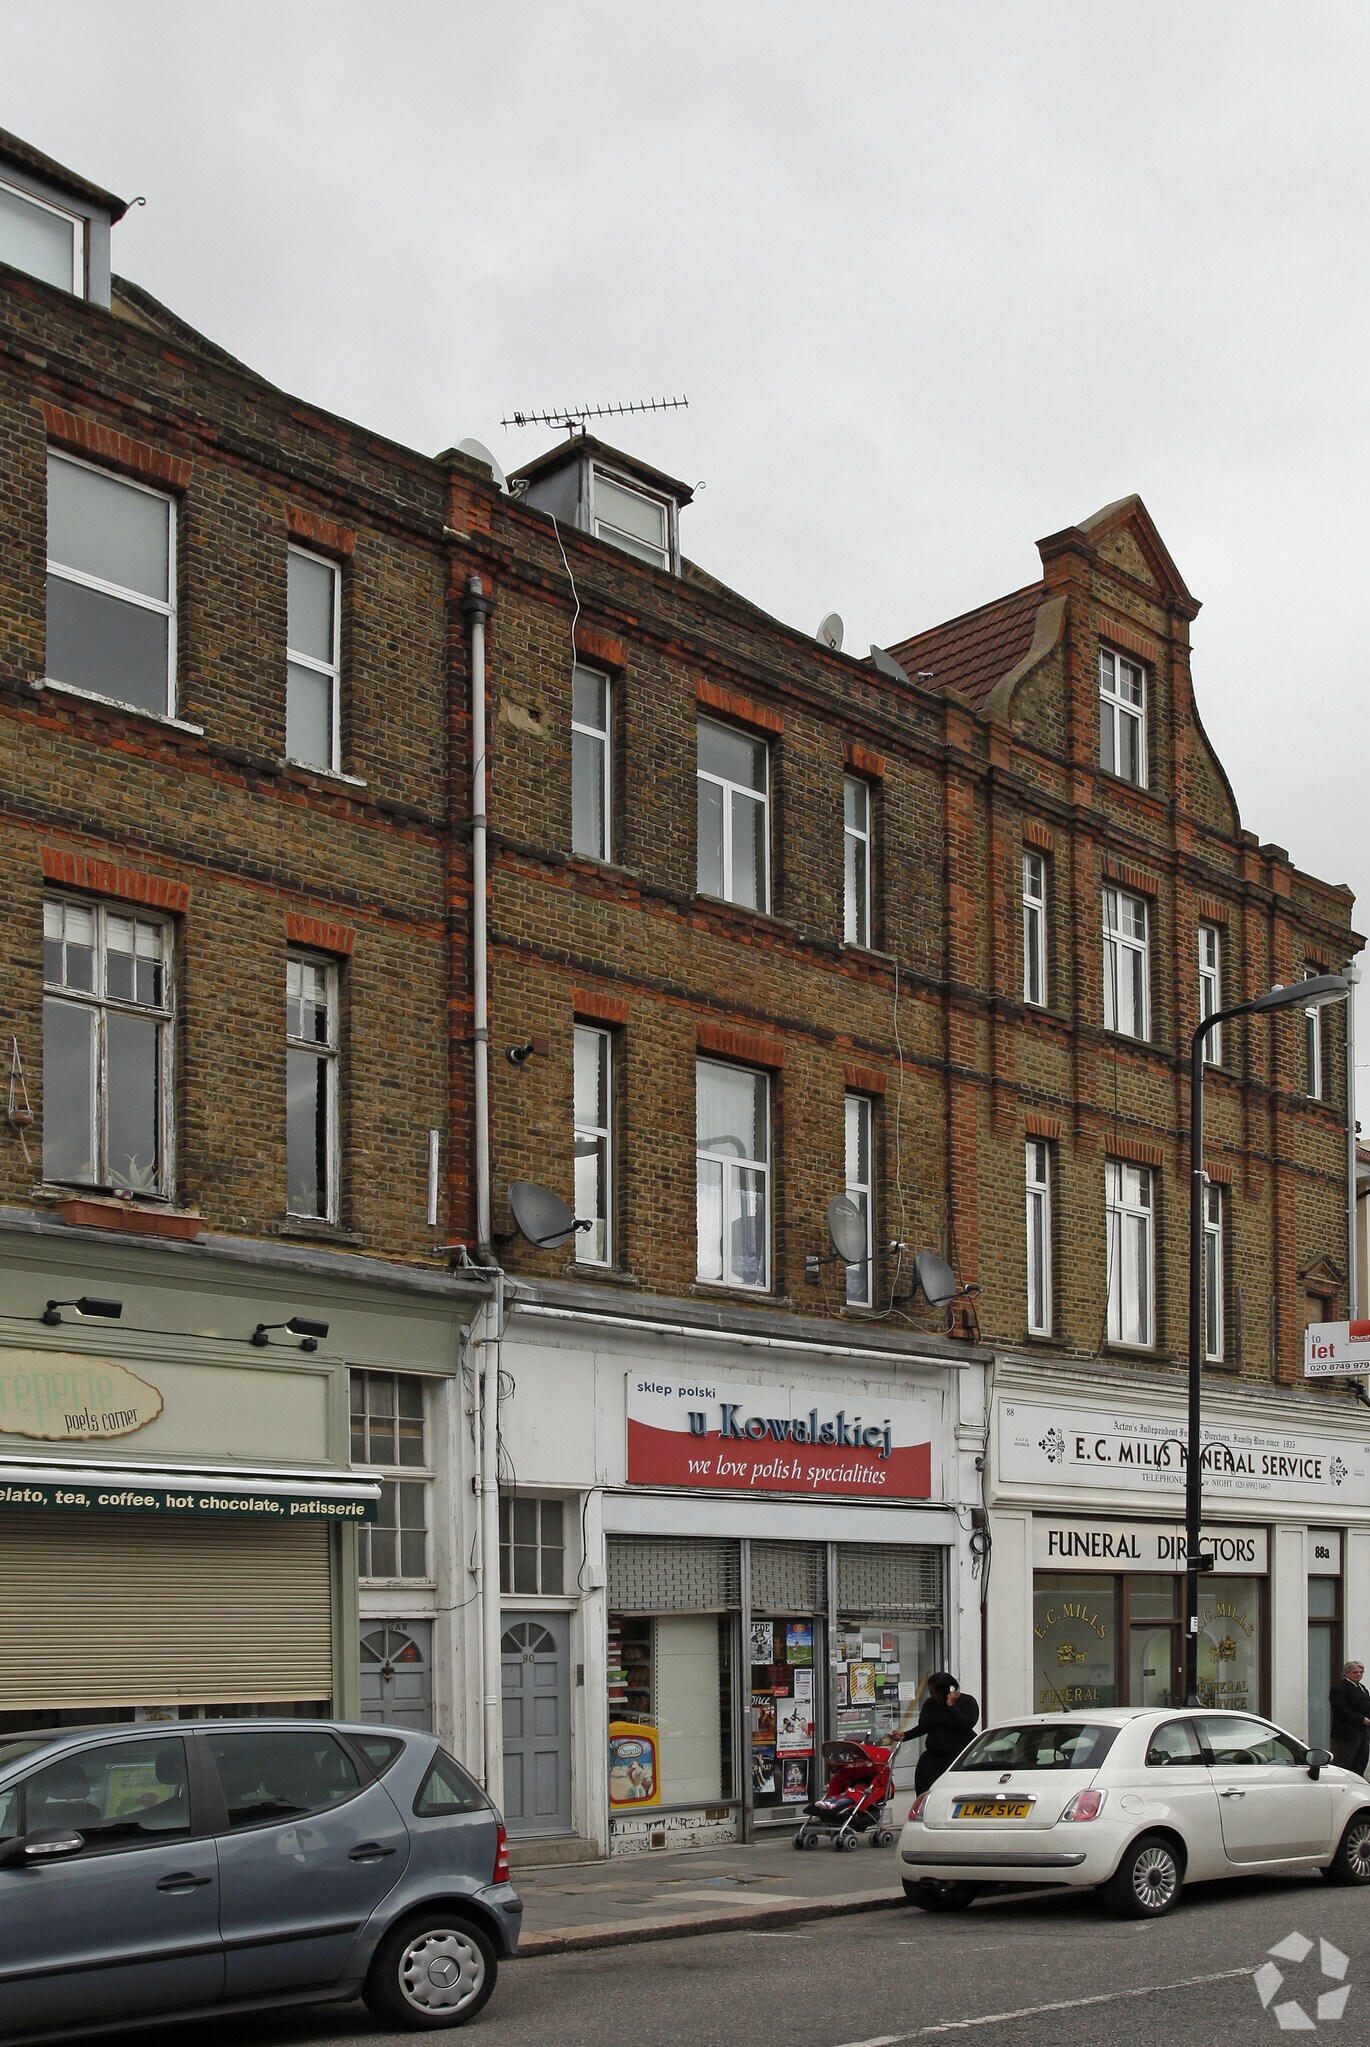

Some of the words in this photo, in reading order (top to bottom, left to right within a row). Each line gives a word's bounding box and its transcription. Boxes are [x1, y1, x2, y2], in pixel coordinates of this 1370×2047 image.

[1311, 1335, 1321, 1343] to
[1311, 1343, 1335, 1359] let
[1329, 1363, 1350, 1371] 8749
[637, 1381, 672, 1397] sklep
[678, 1386, 716, 1399] polski
[64, 1407, 99, 1433] poets
[102, 1408, 138, 1431] corner
[1006, 1408, 1015, 1416] 88
[688, 1411, 708, 1437] u
[719, 1403, 892, 1460] Kowalskiej
[1139, 1423, 1178, 1437] Independent
[1118, 1441, 1171, 1466] MILLS
[1180, 1446, 1256, 1473] FNERAL
[1262, 1454, 1322, 1480] SERVICE
[687, 1459, 710, 1475] we
[716, 1455, 748, 1477] love
[750, 1458, 802, 1484] polish
[806, 1464, 887, 1487] specialities
[1211, 1478, 1233, 1488] NIGHT
[55, 1490, 91, 1507] tea,
[98, 1492, 160, 1509] coffee,
[166, 1494, 195, 1508] hot
[200, 1496, 285, 1514] chocolate,
[290, 1500, 365, 1515] patisserie
[1048, 1530, 1142, 1558] FUNERAL
[1157, 1535, 1255, 1561] DIRCTORS
[1315, 1546, 1330, 1558] 88a
[1063, 1603, 1108, 1639] MILLS
[1216, 1603, 1254, 1638] MILLS
[522, 1653, 535, 1664] 90
[1040, 1687, 1100, 1704] FUNERAL
[1198, 1680, 1249, 1695] FUNERAL
[1201, 1697, 1248, 1710] SERVICE
[963, 1804, 994, 1816] LM12
[996, 1804, 1025, 1816] SVC
